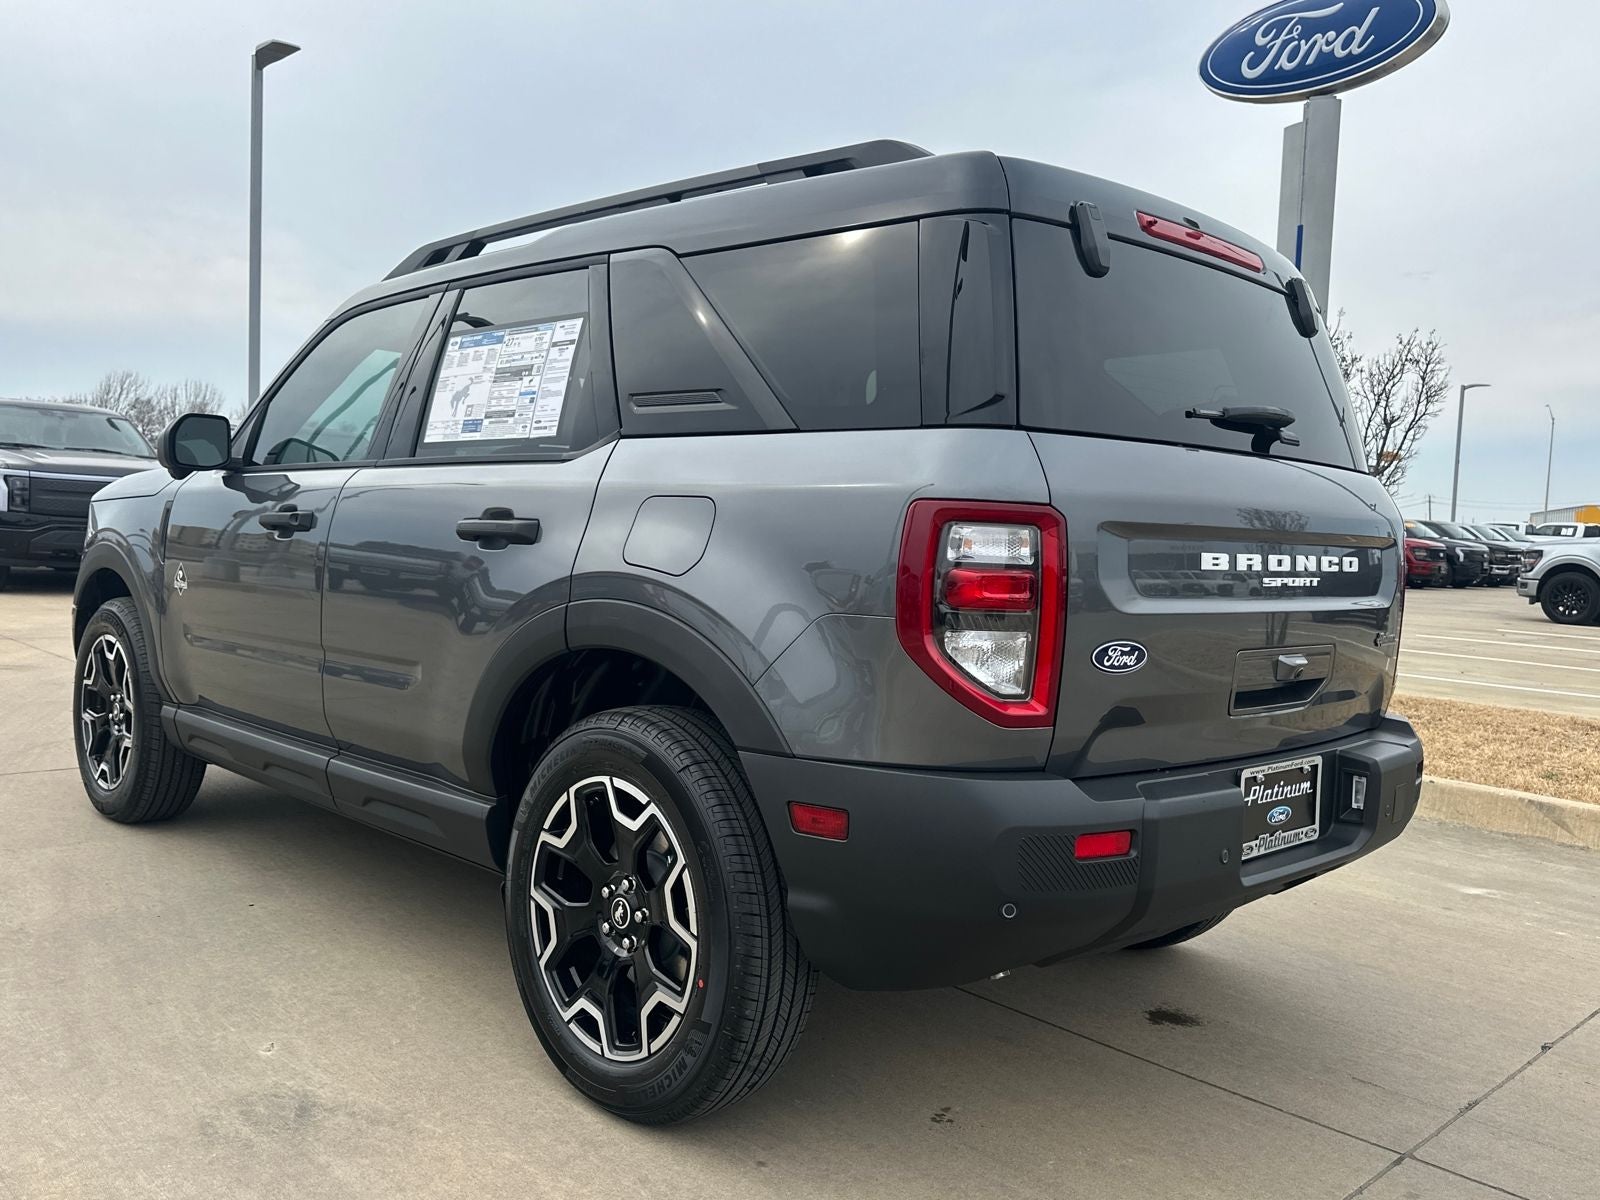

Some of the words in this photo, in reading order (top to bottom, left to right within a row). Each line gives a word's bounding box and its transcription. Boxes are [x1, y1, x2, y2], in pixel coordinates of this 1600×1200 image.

[1240, 2, 1380, 79] Ford
[1200, 552, 1359, 573] BRONCO
[1262, 577, 1321, 588] SPORT
[1103, 645, 1140, 667] Ford
[530, 747, 577, 798] MICHELIN
[1244, 780, 1313, 806] Platinum
[1271, 809, 1289, 823] Ford
[1257, 831, 1303, 854] Platinum
